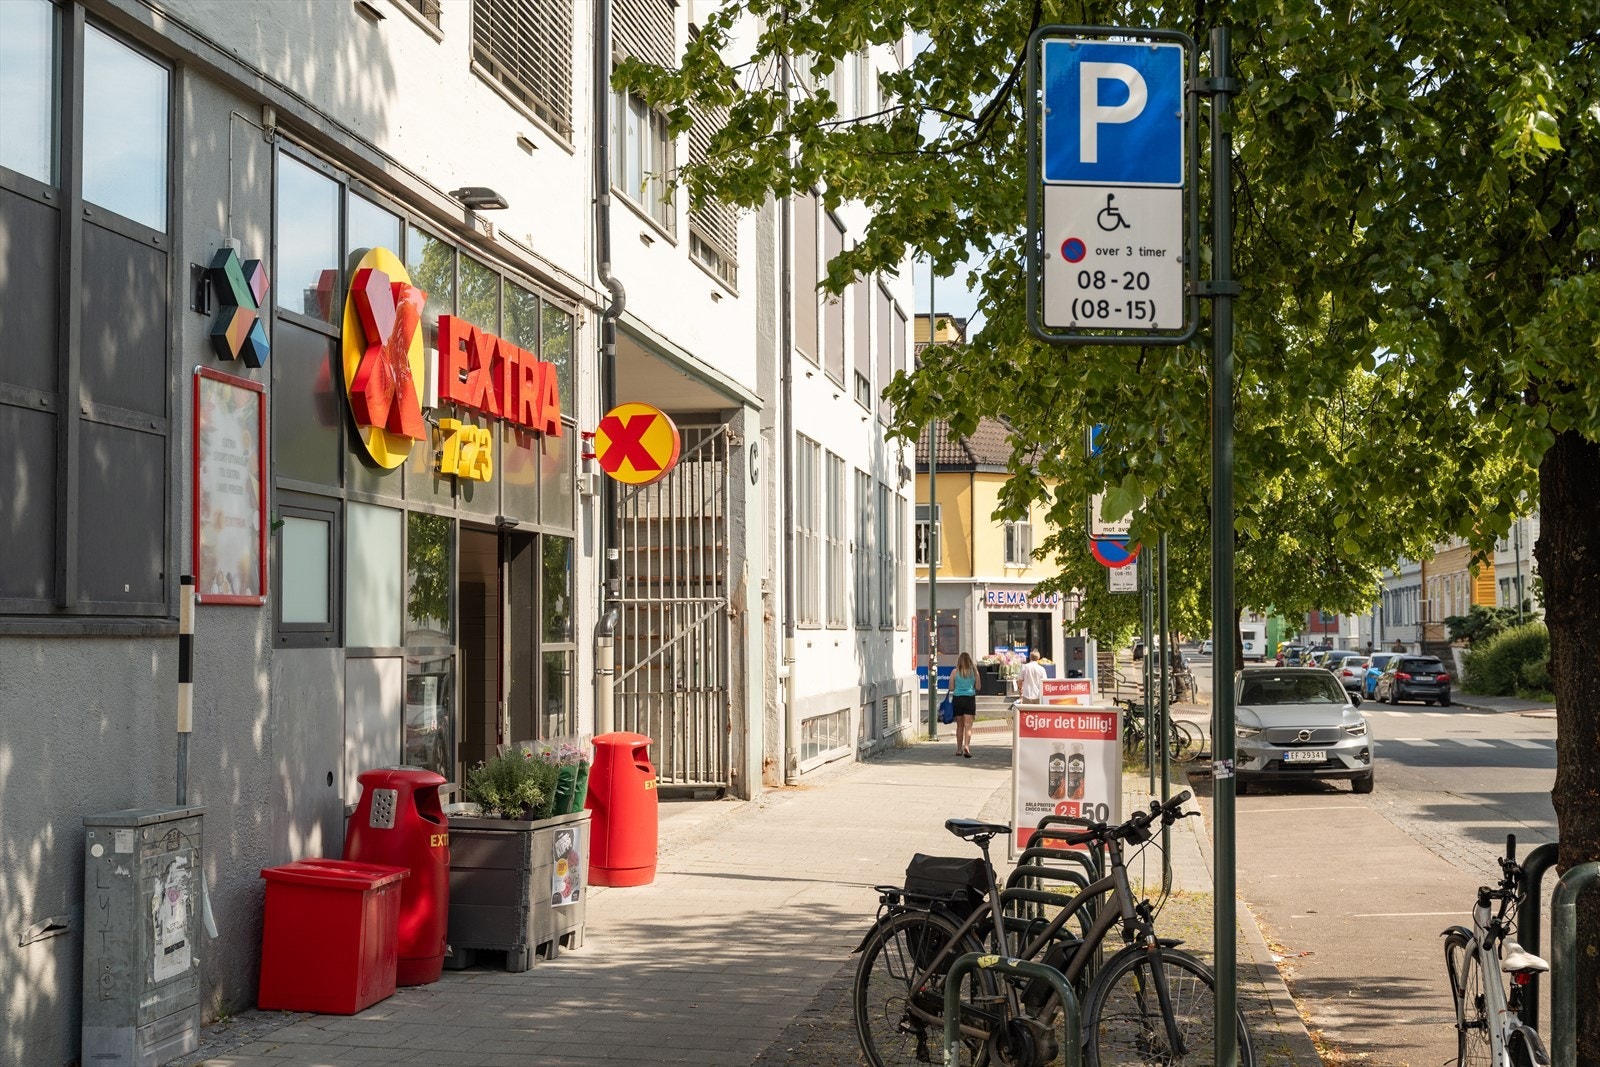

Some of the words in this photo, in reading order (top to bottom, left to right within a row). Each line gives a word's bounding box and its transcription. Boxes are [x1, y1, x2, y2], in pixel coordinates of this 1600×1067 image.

[1080, 61, 1148, 163] P
[1095, 247, 1120, 256] over
[1126, 246, 1133, 256] 3
[1139, 246, 1167, 257] timer
[438, 314, 563, 437] EXTRA
[988, 591, 1026, 604] REMA
[1044, 684, 1058, 692] Gjør
[1071, 683, 1088, 692] billig!
[1025, 714, 1051, 731] Gjør
[1054, 715, 1075, 729] det
[1078, 716, 1112, 733] billig!
[1290, 751, 1299, 759] EF
[1302, 751, 1325, 759] 29341
[1060, 805, 1068, 817] 2
[1082, 802, 1110, 823] 50
